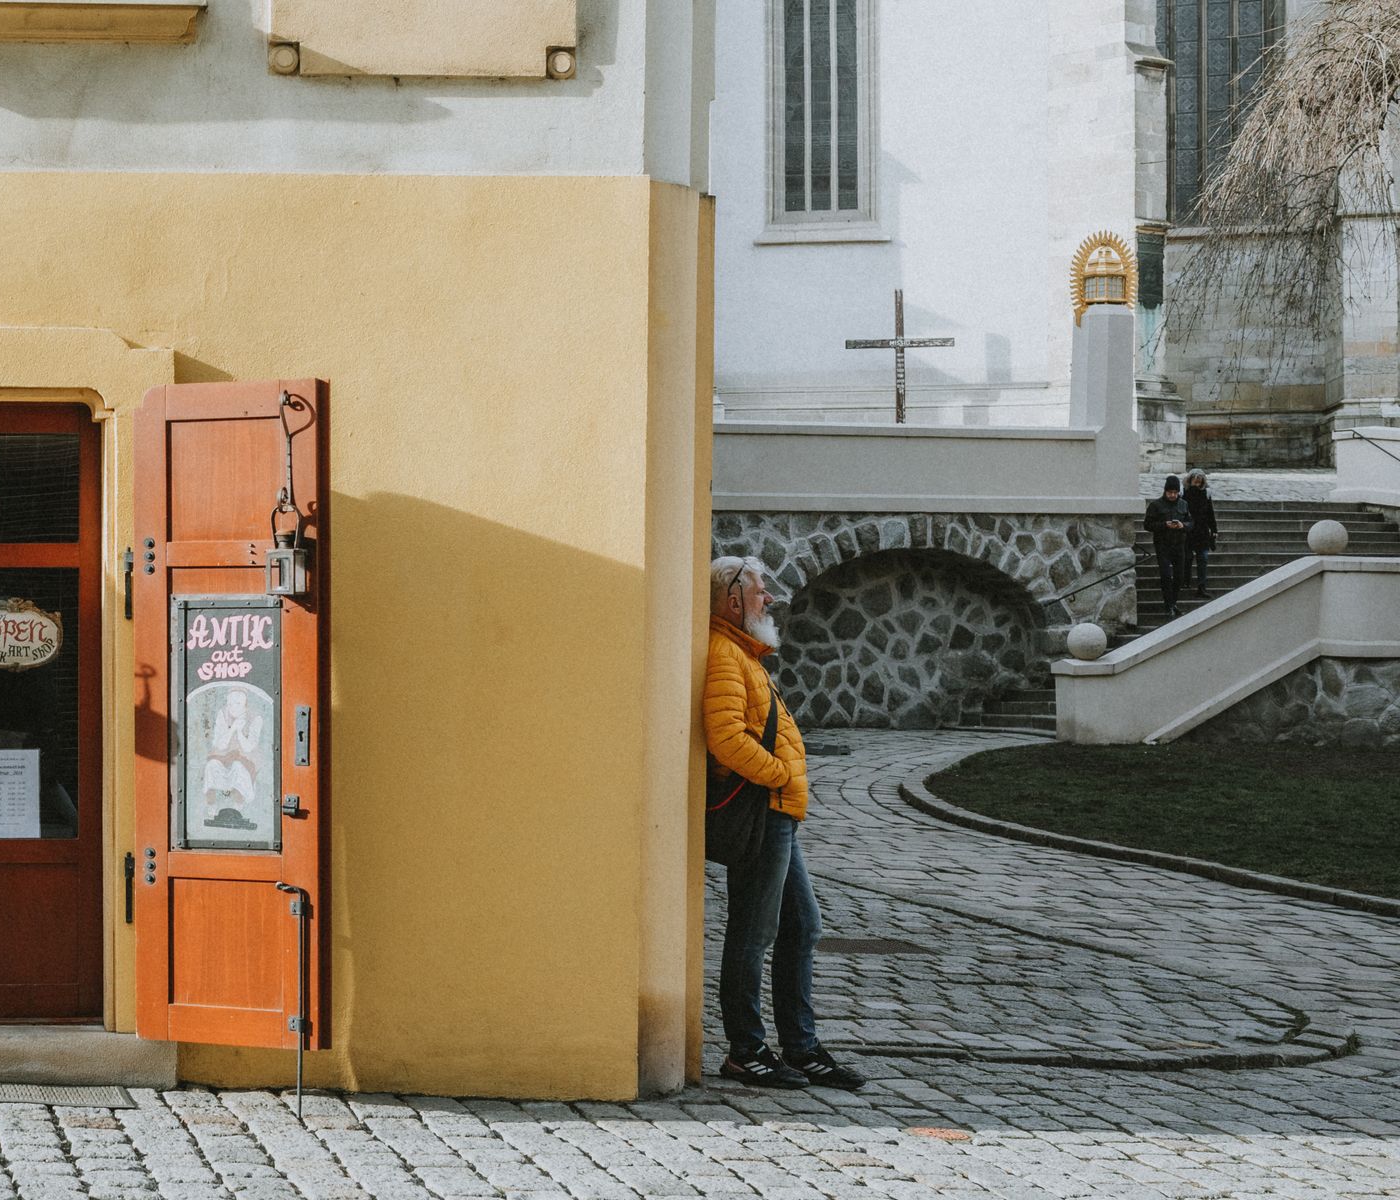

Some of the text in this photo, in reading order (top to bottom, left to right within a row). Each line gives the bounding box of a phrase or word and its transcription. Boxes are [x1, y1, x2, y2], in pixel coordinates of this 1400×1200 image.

[7, 644, 31, 657] ART
[211, 648, 244, 662] art
[197, 661, 252, 680] SHOP
